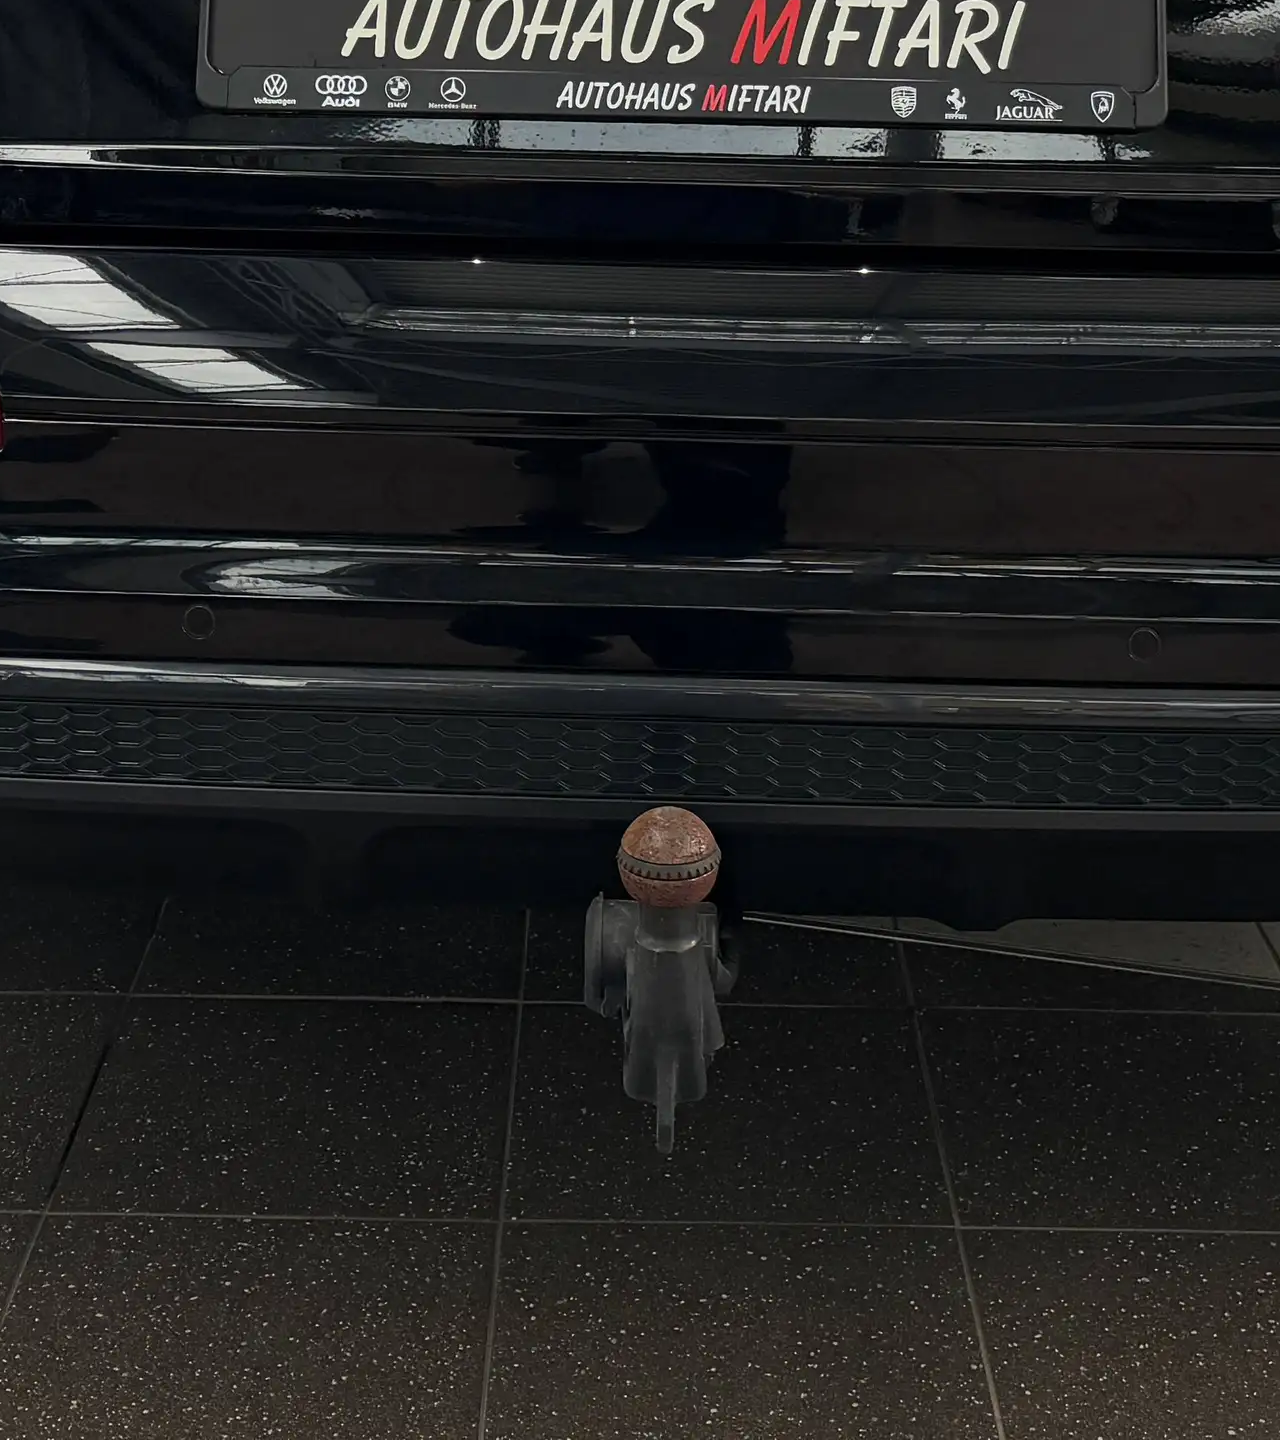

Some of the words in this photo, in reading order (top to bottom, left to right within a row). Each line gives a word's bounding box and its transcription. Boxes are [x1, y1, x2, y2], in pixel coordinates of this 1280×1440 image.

[321, 95, 361, 108] Audi
[555, 80, 696, 111] AUTOHAUS
[701, 83, 812, 114] MIFTARI
[995, 105, 1055, 120] JAGUAR
